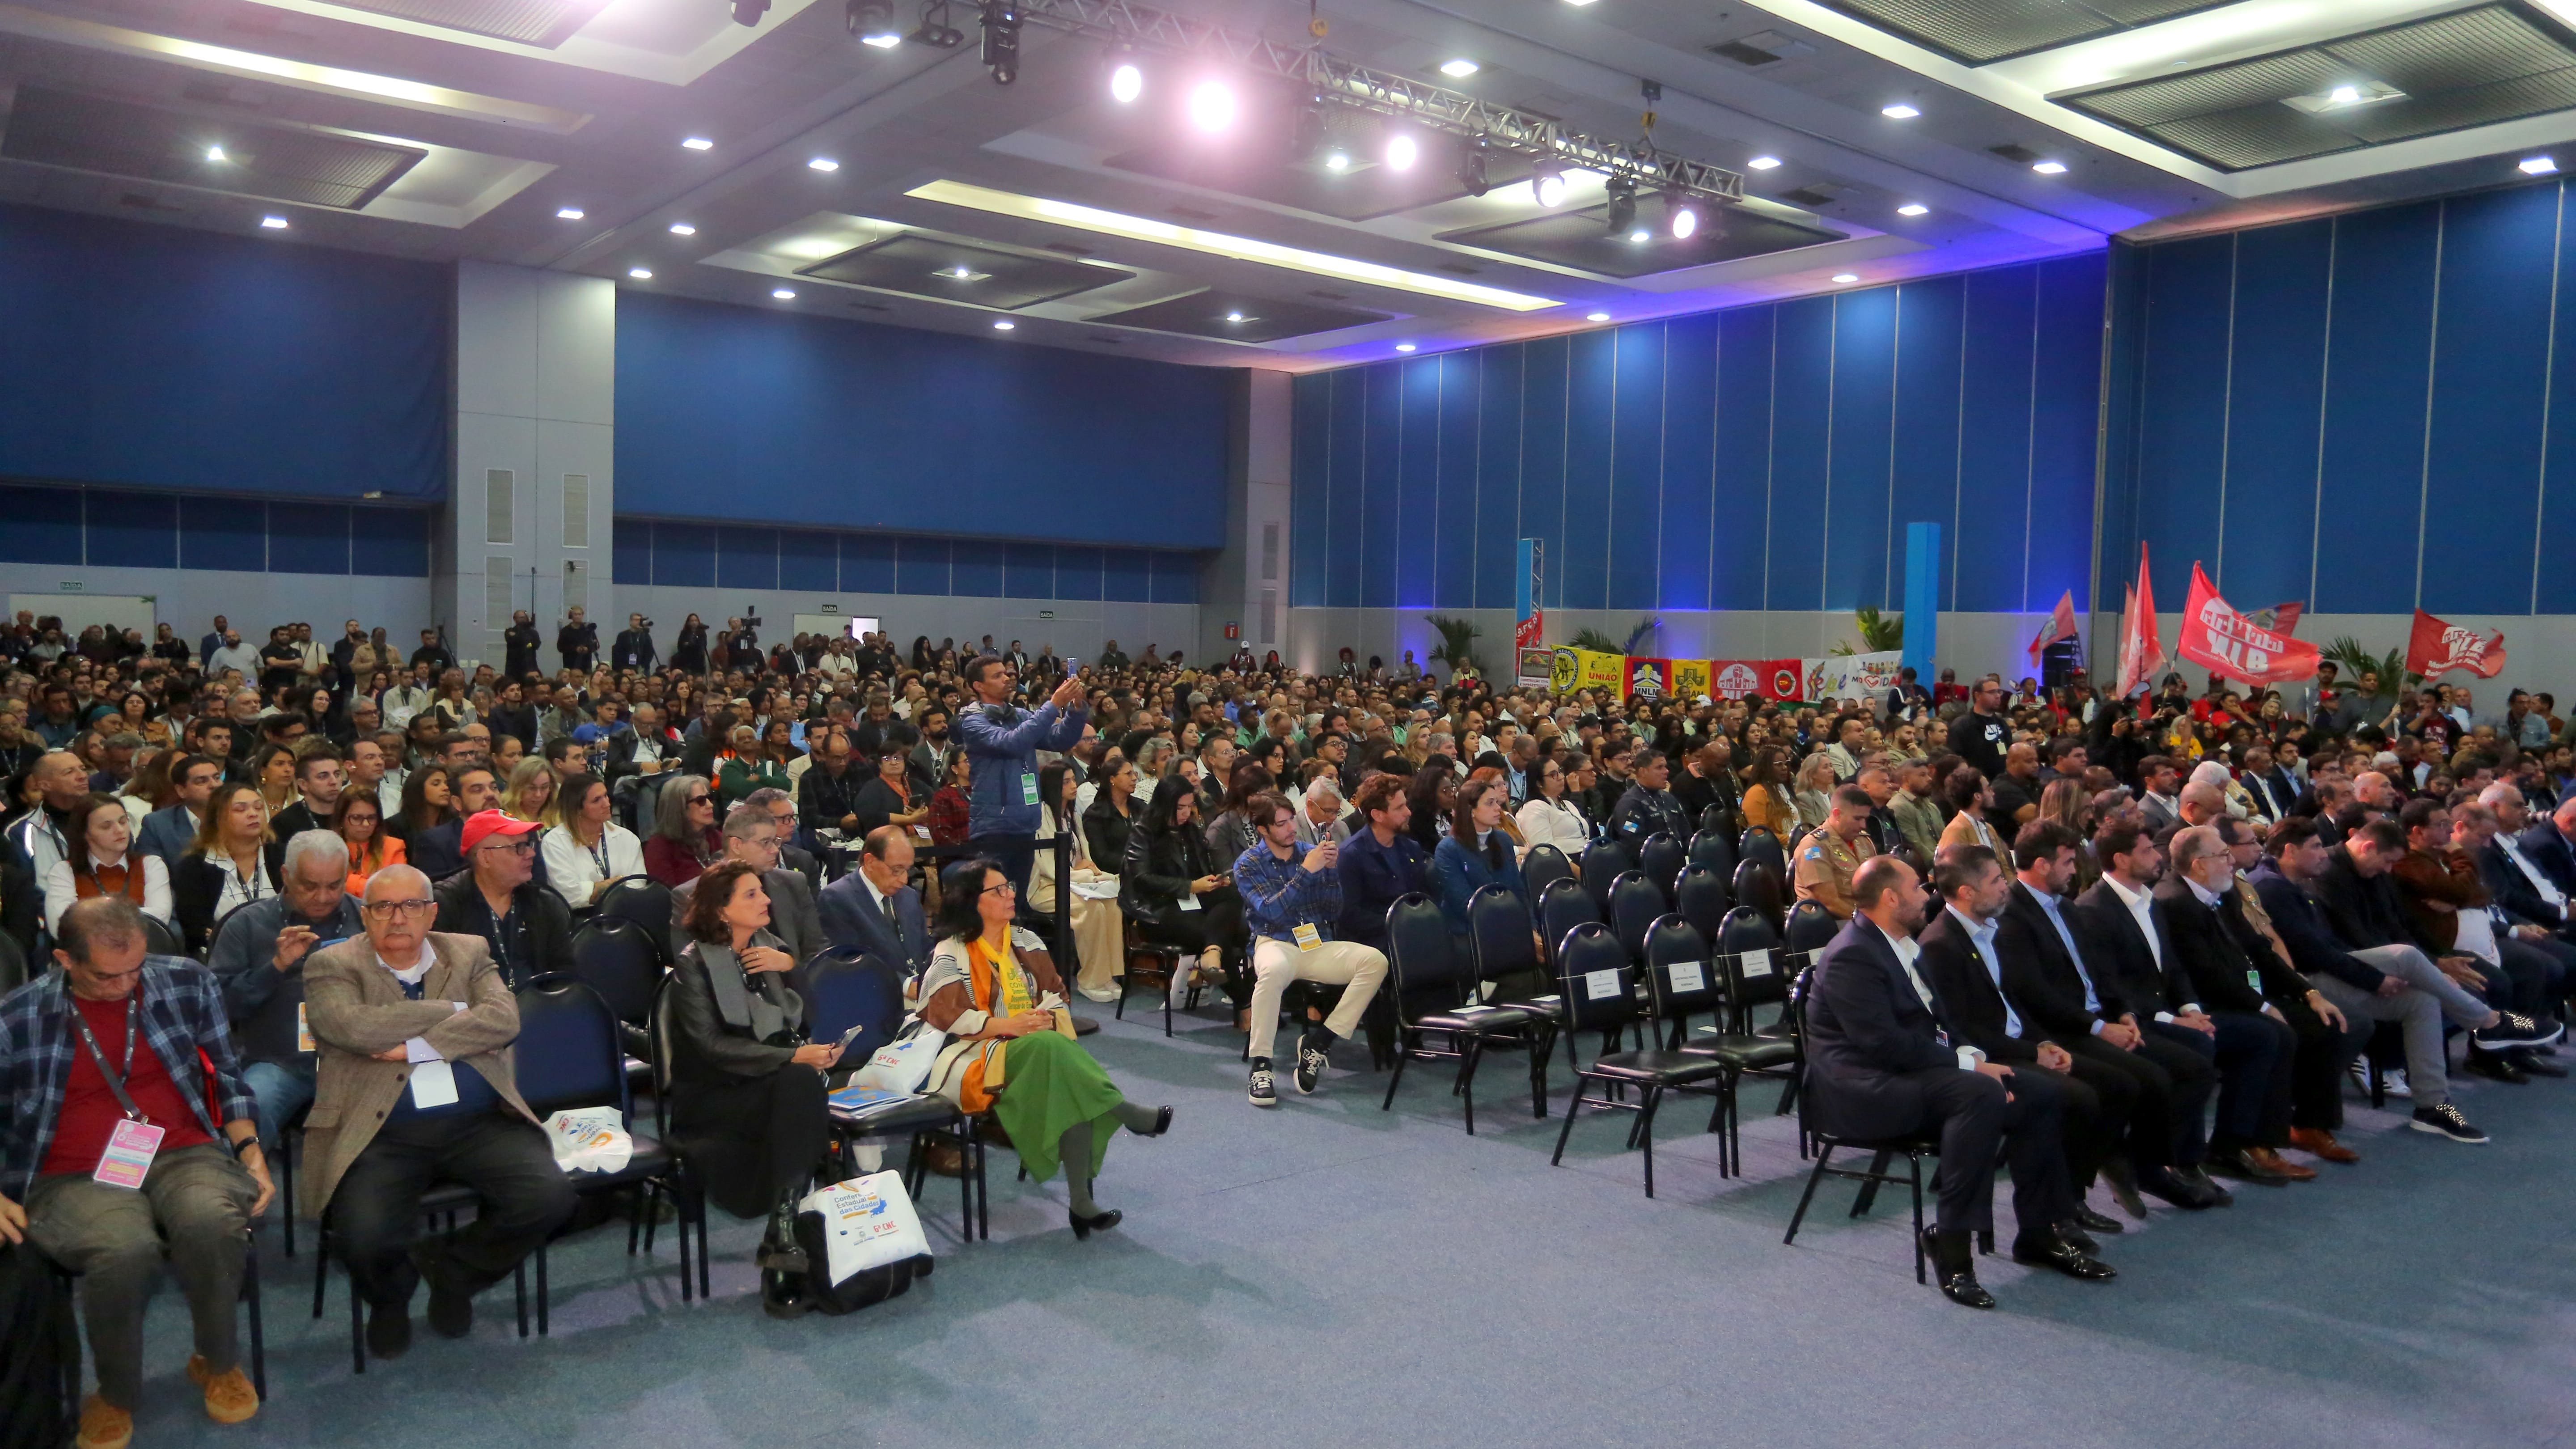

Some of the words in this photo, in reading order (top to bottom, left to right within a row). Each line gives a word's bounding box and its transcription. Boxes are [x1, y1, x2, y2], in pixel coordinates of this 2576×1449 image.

[837, 1197, 867, 1209] Estadual
[853, 1201, 879, 1211] Cidades
[873, 1224, 881, 1233] 6ª
[882, 1220, 897, 1230] CNC
